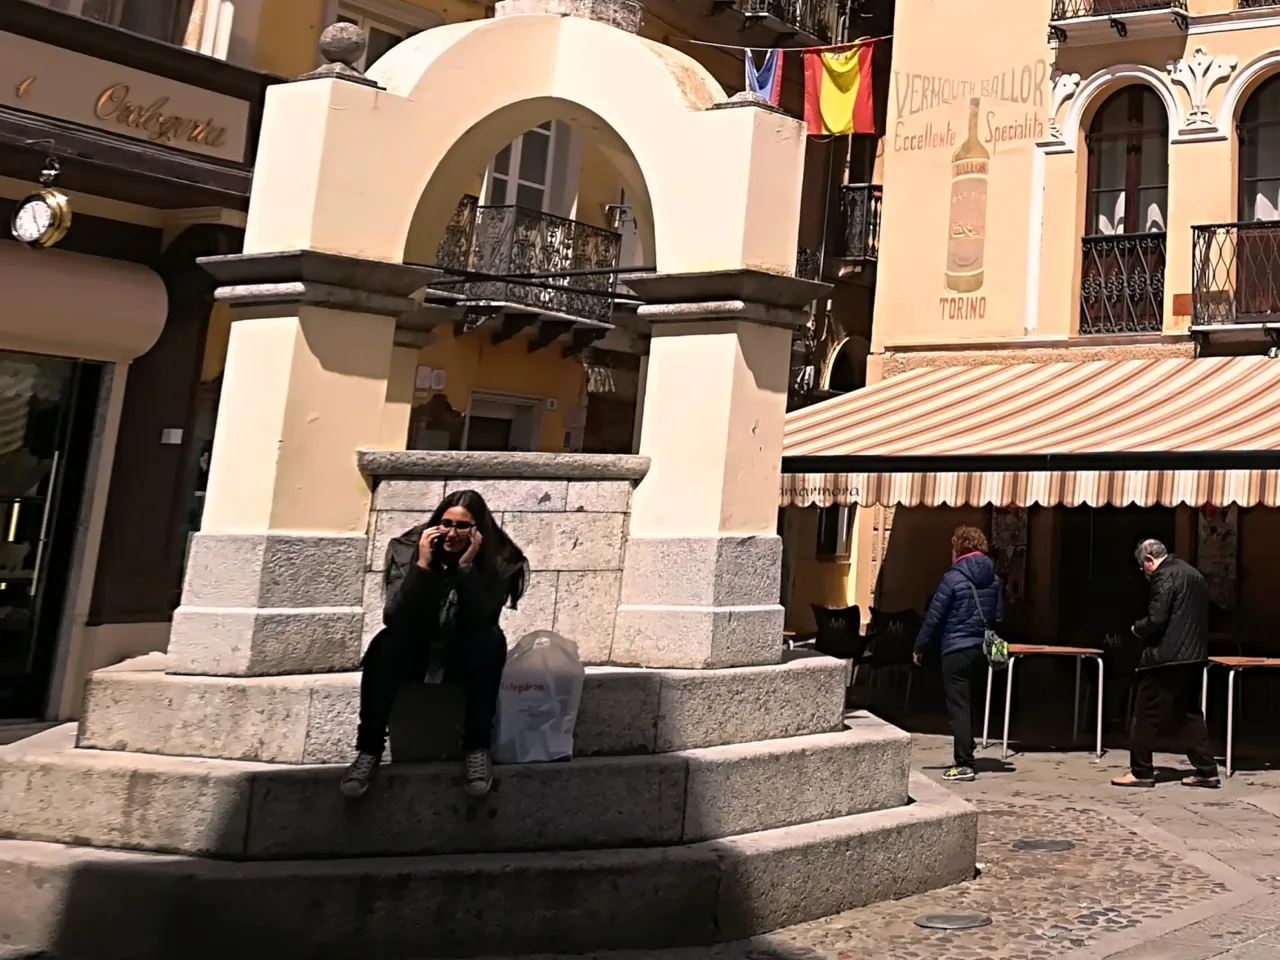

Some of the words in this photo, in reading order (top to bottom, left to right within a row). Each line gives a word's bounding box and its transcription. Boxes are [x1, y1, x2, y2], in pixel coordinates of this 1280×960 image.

[980, 58, 1047, 108] BALLOR
[893, 120, 957, 153] Eccellente
[939, 295, 987, 321] TORINO
